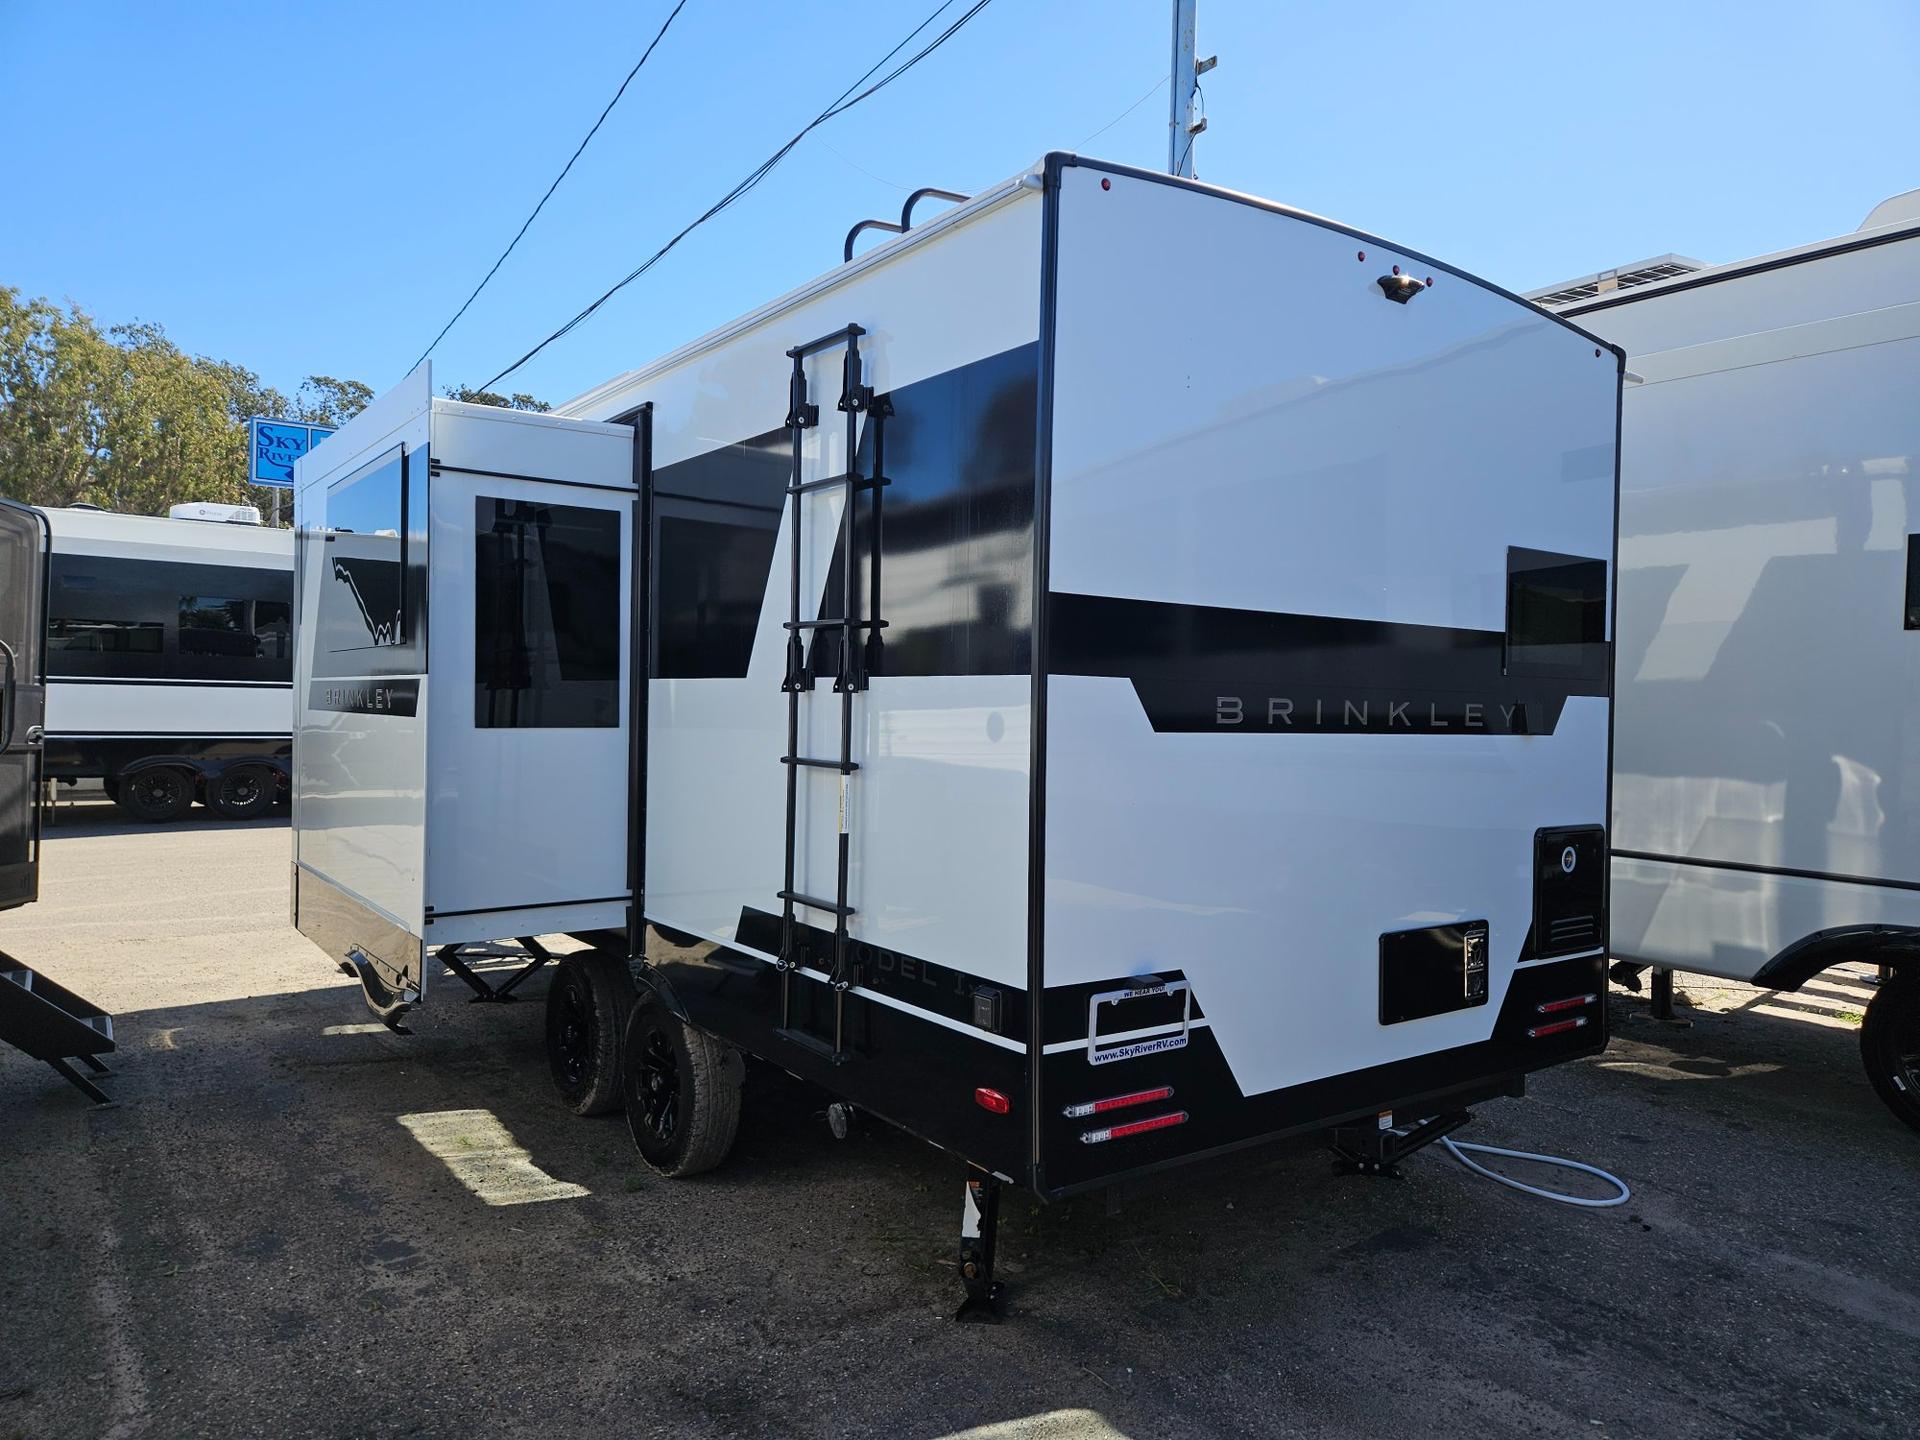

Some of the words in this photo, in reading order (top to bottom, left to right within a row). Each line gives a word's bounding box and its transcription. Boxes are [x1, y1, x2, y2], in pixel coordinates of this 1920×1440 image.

[258, 426, 305, 451] SKY
[325, 687, 394, 709] BRINKLEY
[1215, 695, 1517, 728] BRINKLEY
[1094, 1037, 1187, 1063] www.SkyRiverRV.com
